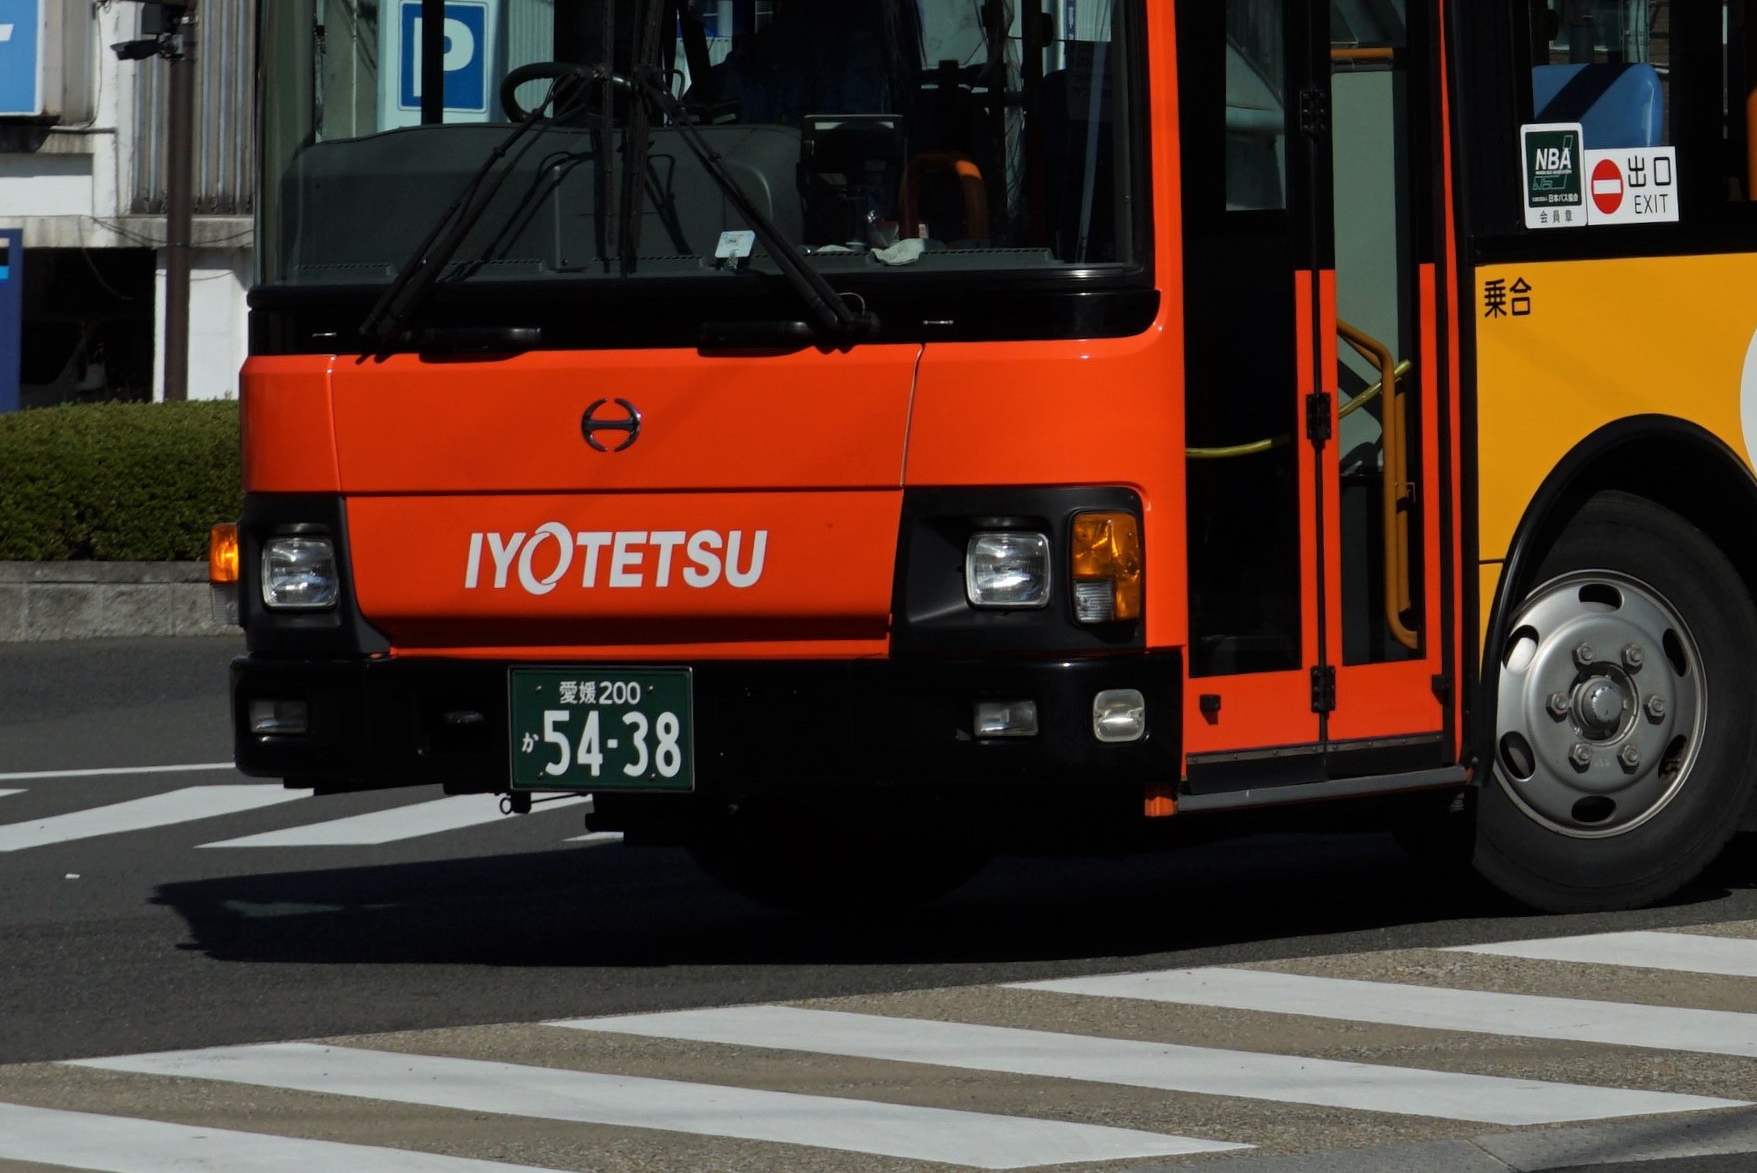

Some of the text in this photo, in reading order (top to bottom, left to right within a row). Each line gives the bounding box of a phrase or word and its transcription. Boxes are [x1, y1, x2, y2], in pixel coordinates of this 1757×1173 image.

[413, 17, 474, 97] P
[1535, 147, 1572, 171] NBA
[1627, 155, 1671, 188] 出口
[1540, 209, 1573, 224] 会員章
[1634, 194, 1668, 214] EXIT
[1484, 277, 1532, 318] 乗合
[464, 521, 768, 595] IYOTETSU
[521, 732, 540, 754] か
[543, 709, 682, 778] 54-38
